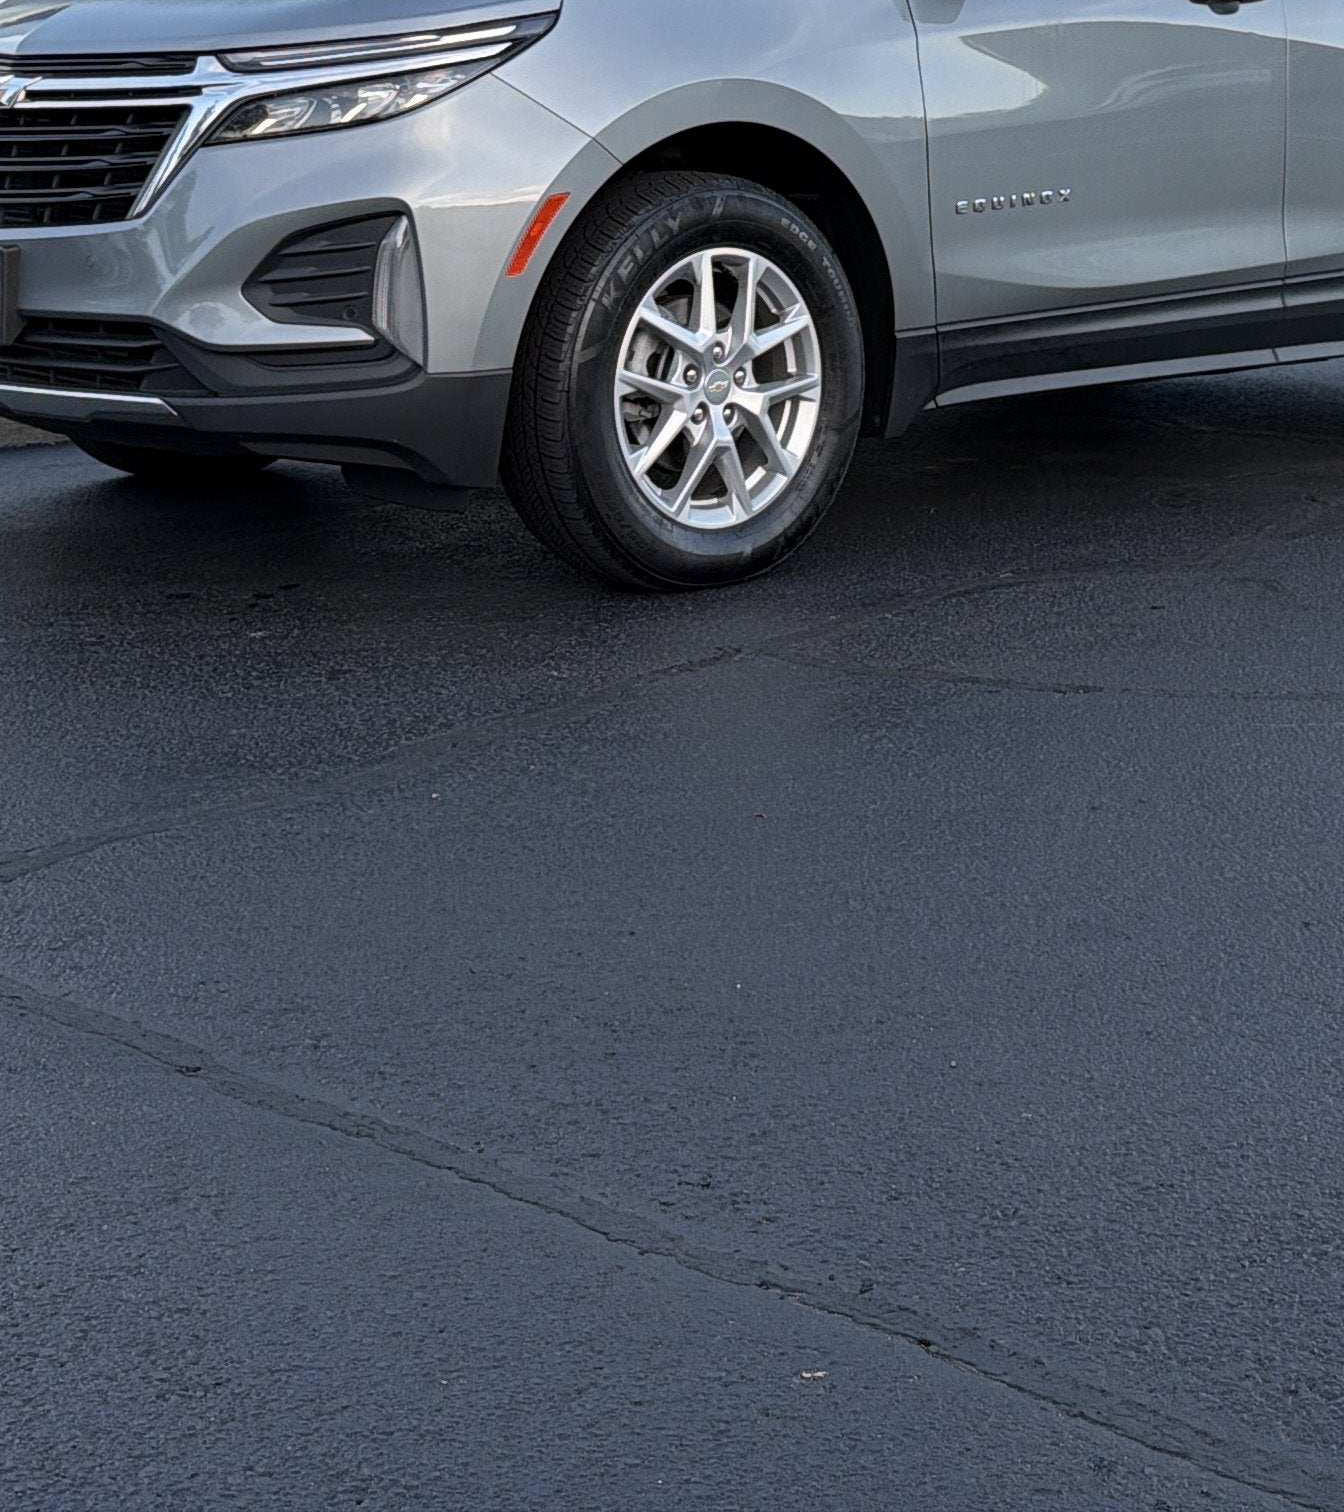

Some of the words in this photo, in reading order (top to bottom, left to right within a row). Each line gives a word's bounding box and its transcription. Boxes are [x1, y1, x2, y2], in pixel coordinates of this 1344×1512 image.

[955, 188, 1071, 215] EQUINOX
[781, 217, 818, 251] EDGE
[600, 212, 682, 311] KELLY
